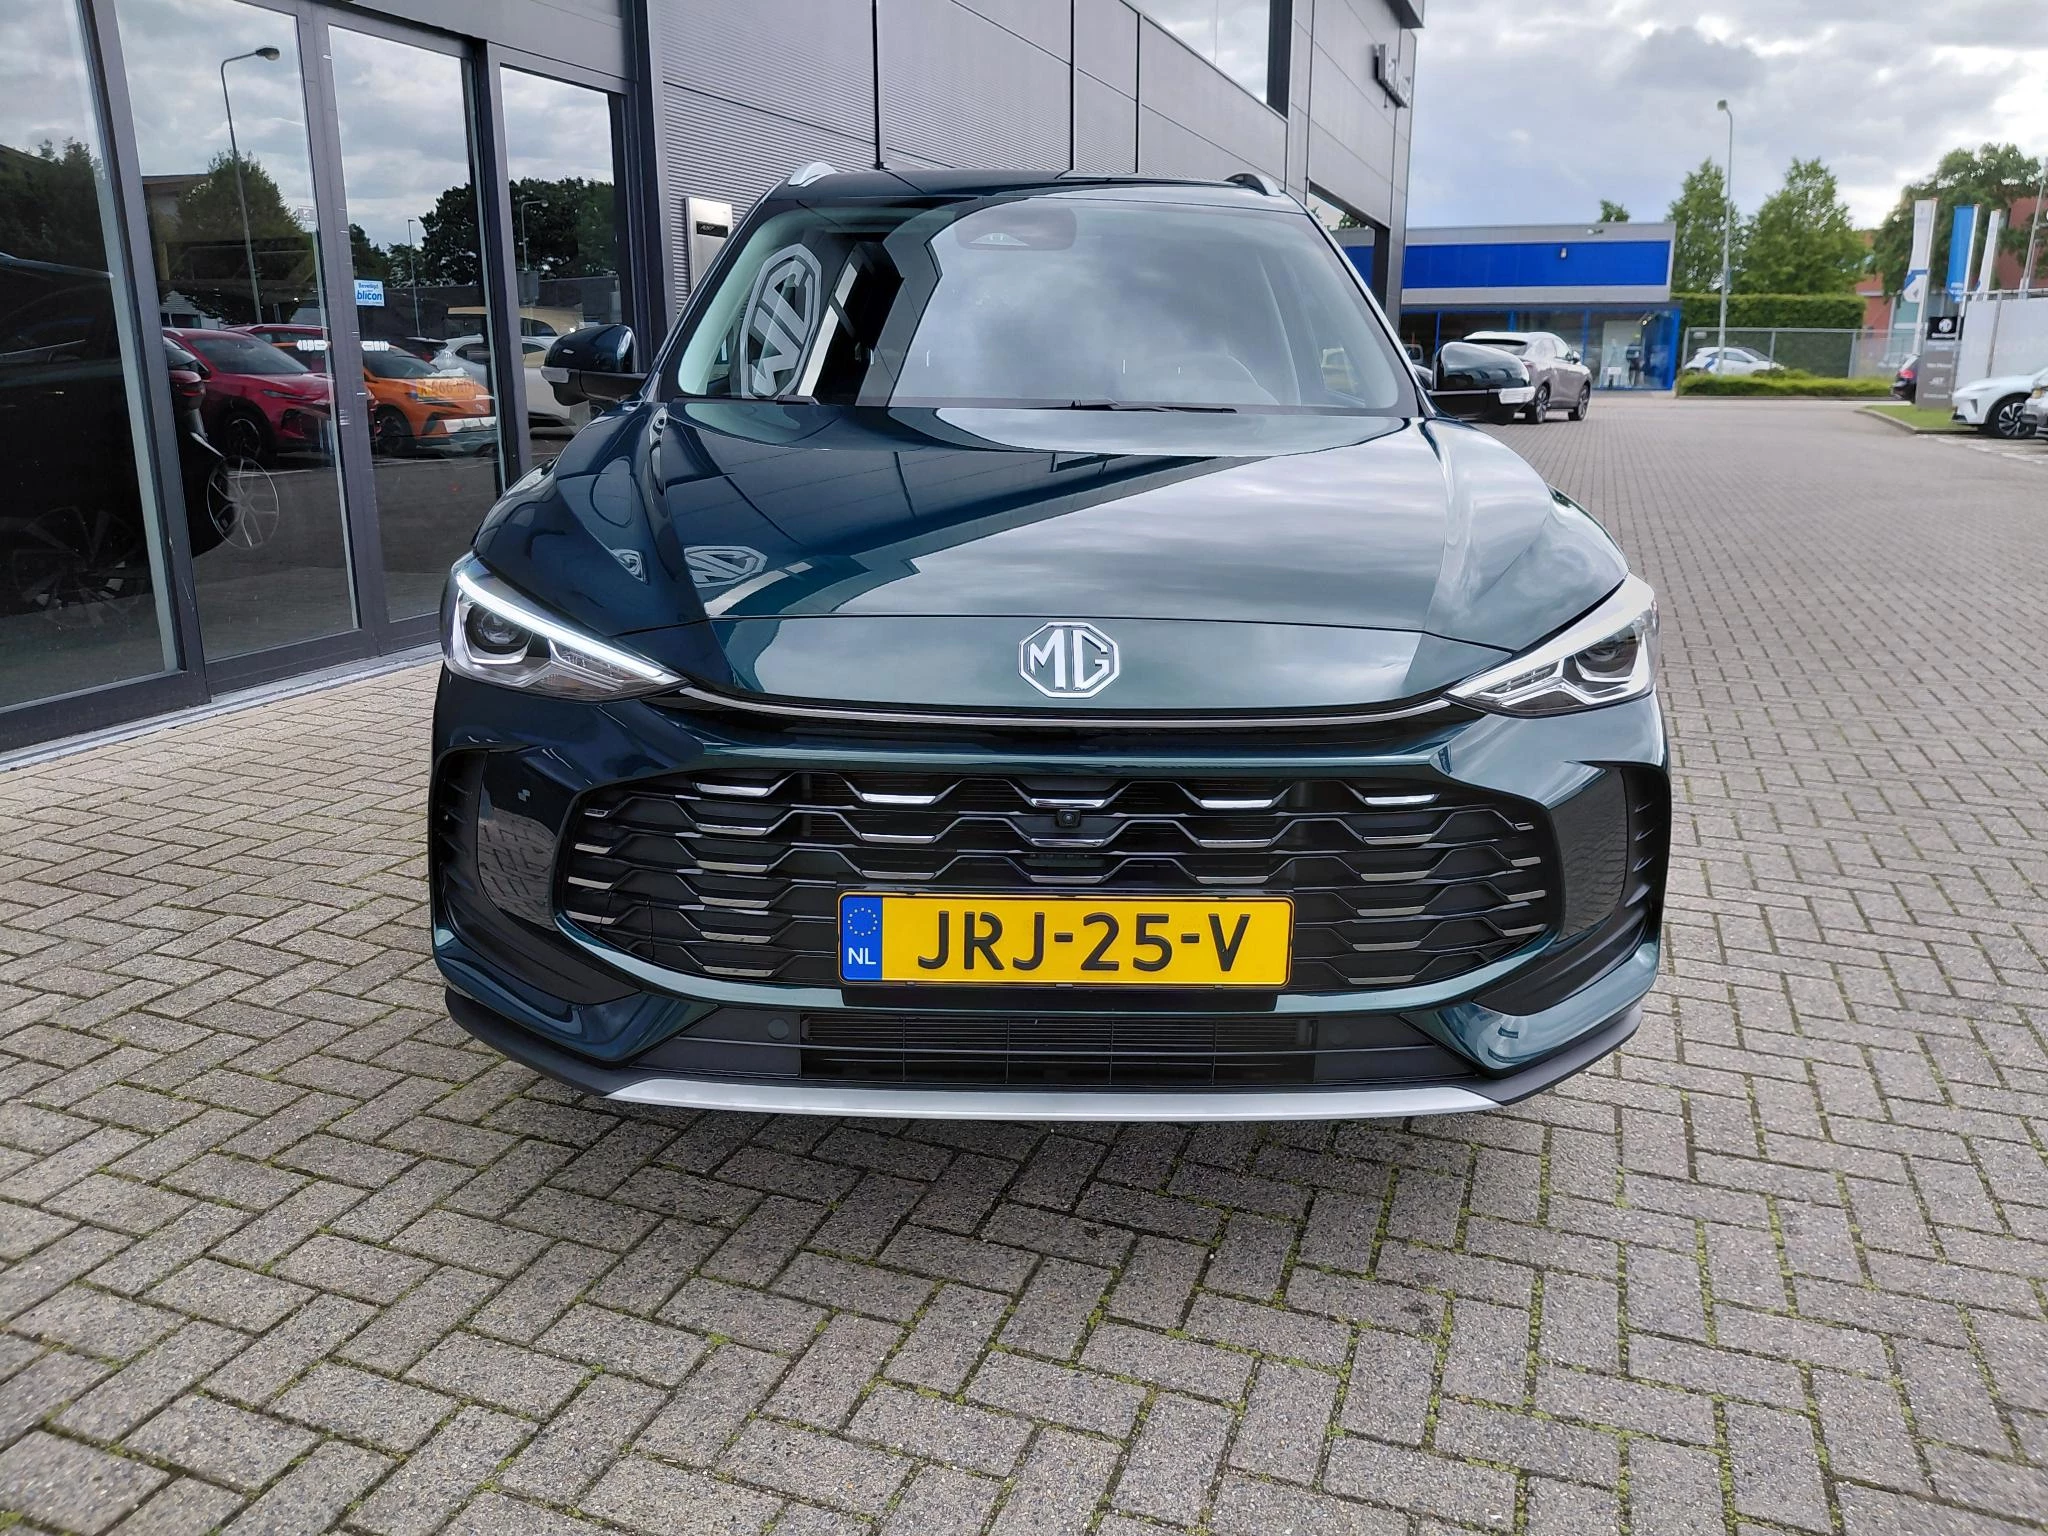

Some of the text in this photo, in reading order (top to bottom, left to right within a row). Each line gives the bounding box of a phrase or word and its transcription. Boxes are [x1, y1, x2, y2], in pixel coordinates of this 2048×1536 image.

[1027, 628, 1111, 691] MG
[848, 947, 877, 966] NL
[917, 910, 1252, 972] JRJ-25-V
